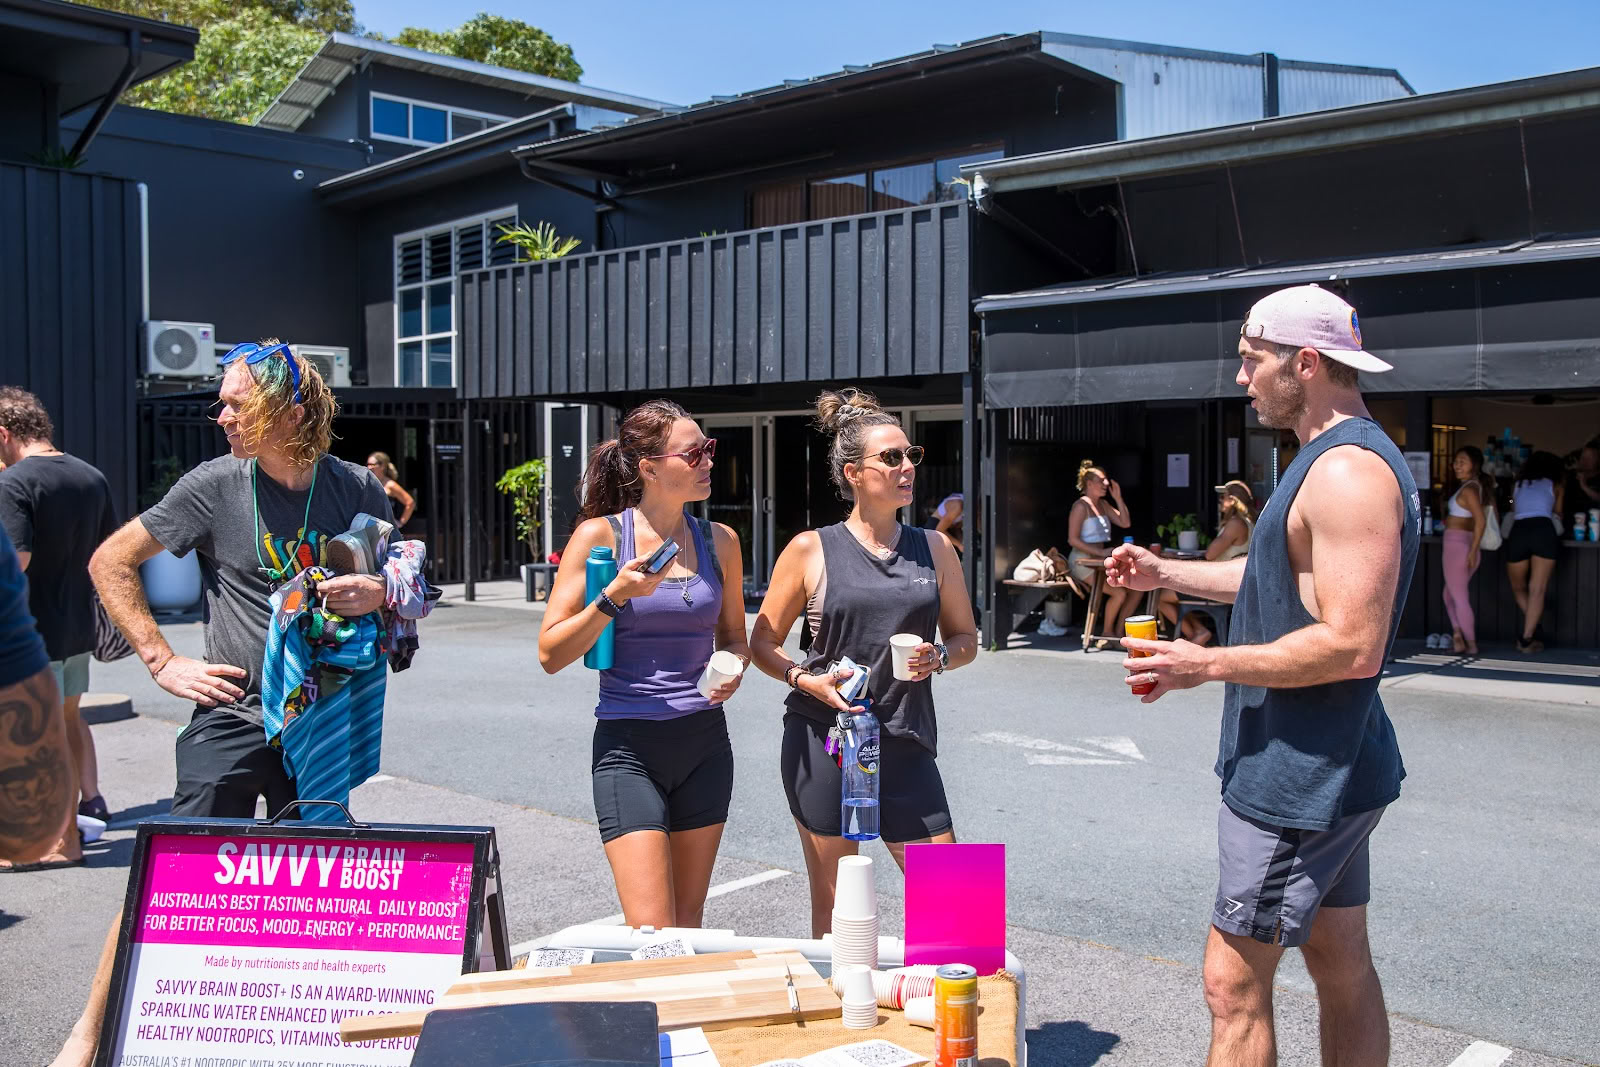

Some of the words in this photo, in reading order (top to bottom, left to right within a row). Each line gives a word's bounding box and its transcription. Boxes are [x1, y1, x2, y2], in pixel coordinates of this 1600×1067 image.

[213, 842, 341, 888] SAVVY
[342, 846, 406, 869] BRAIN
[340, 867, 403, 890] BOOST
[149, 892, 228, 909] AUSTRALIA'S
[230, 894, 260, 911] BEST
[263, 895, 313, 913] TASTING
[316, 898, 372, 915] NATURAL
[378, 900, 417, 917] DAILY
[418, 901, 459, 918] BOOST
[143, 914, 167, 931] FOR
[169, 915, 215, 932] BETTER
[216, 916, 259, 936] FOCUS,
[306, 919, 355, 937] ENERGY
[357, 925, 364, 936] +
[367, 922, 463, 941] PERFORMANCE.
[204, 955, 230, 968] Made
[231, 957, 242, 971] by
[244, 957, 300, 970] nutritionists
[302, 959, 320, 971] and
[321, 959, 350, 972] health
[351, 962, 386, 975] experts
[155, 979, 197, 996] SAVVY
[199, 980, 238, 997] BRAIN
[240, 982, 287, 999] BOOST+
[290, 984, 302, 999] IS
[305, 984, 323, 1000] AN
[325, 985, 435, 1005] AWARD-WINNING
[140, 1001, 210, 1019] SPARKLING
[214, 1004, 257, 1021] WATER
[260, 1006, 327, 1023] ENHANCED
[136, 1024, 194, 1041] HEALTHY
[196, 1026, 276, 1046] NOOTROPICS,
[280, 1029, 340, 1048] VITAMINS
[119, 1054, 178, 1067] AUSTRALIA'S
[180, 1056, 192, 1067] #1
[194, 1057, 247, 1067] NOOTROPIC
